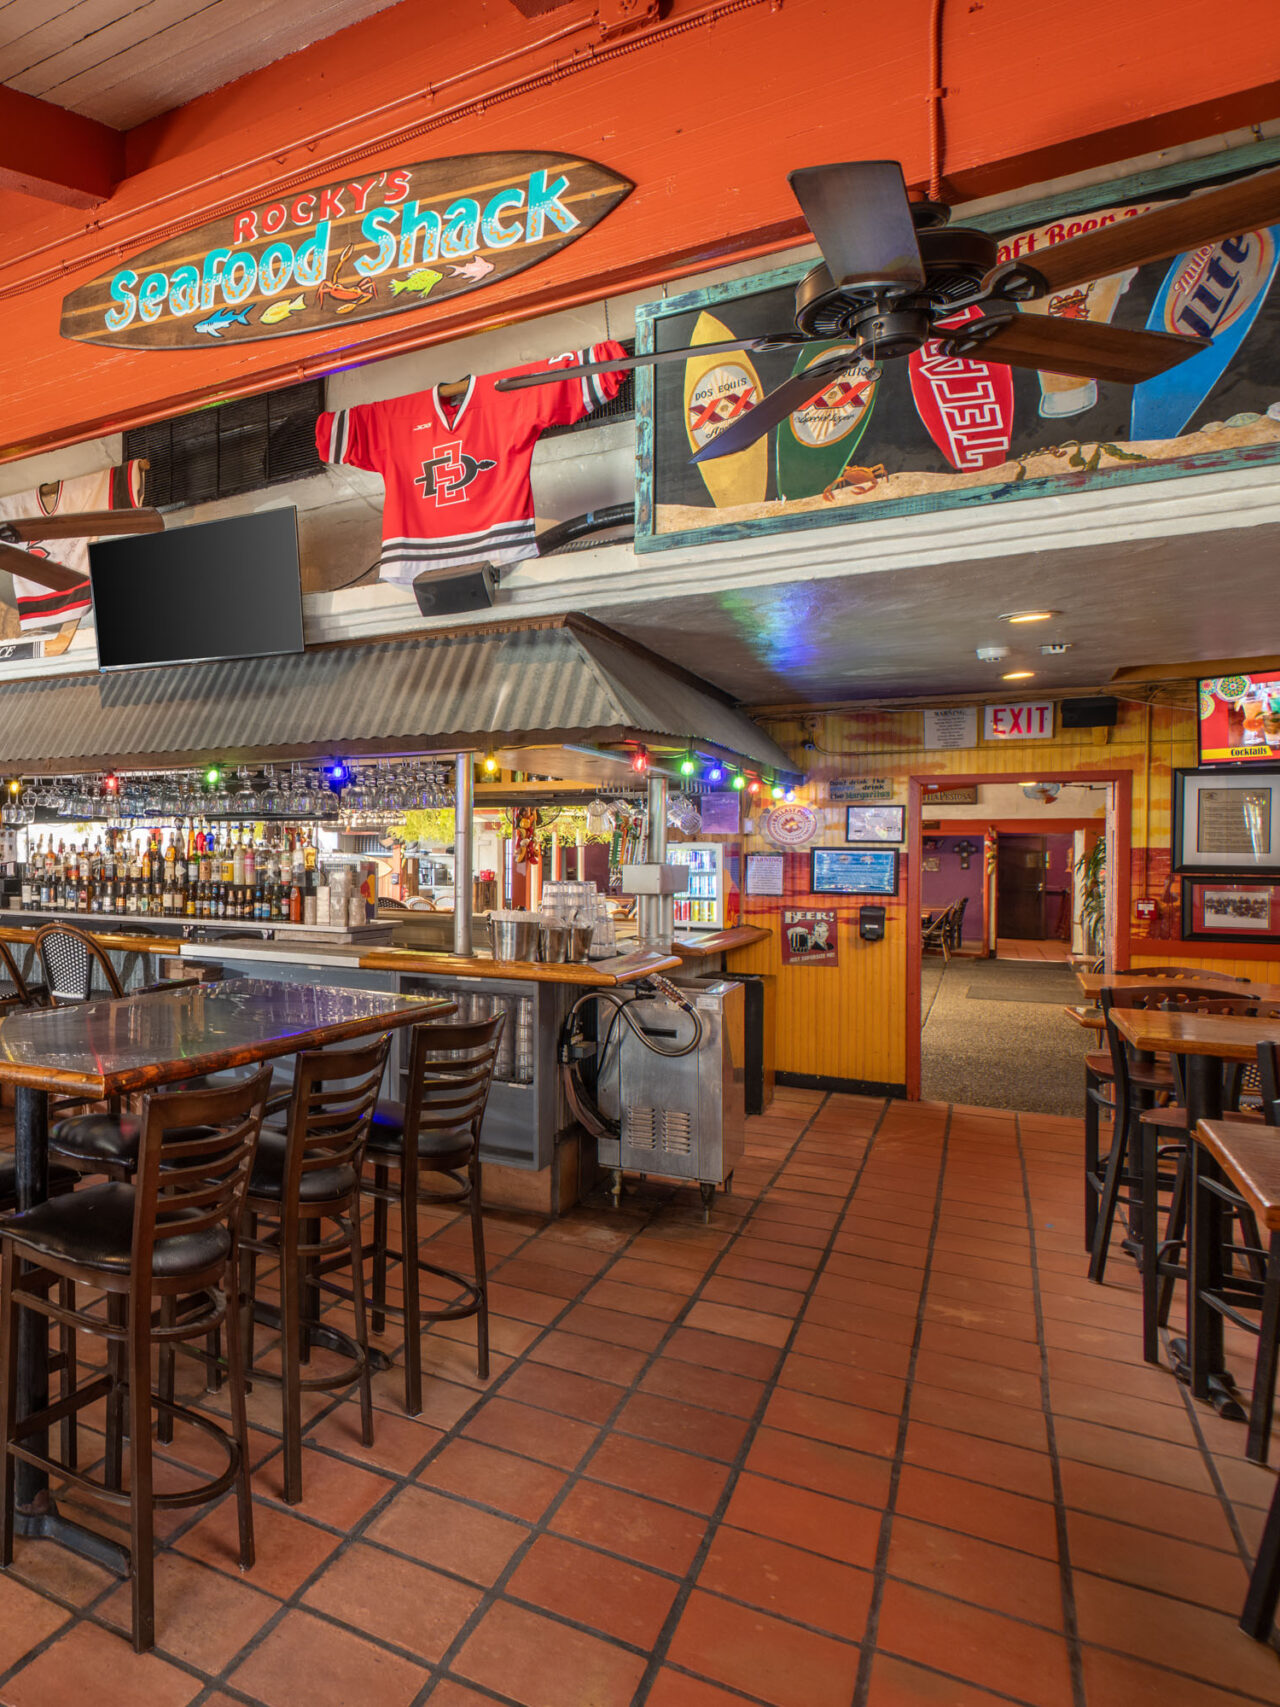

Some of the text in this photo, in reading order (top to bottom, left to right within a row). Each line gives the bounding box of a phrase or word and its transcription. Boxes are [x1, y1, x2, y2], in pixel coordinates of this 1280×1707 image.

[233, 170, 412, 244] ROCKY'S
[105, 168, 581, 332] Seafood Shack
[695, 377, 747, 401] DOS EQUIS
[992, 706, 1049, 735] EXIT
[1231, 747, 1268, 756] Cocktails
[784, 911, 835, 924] BEER!
